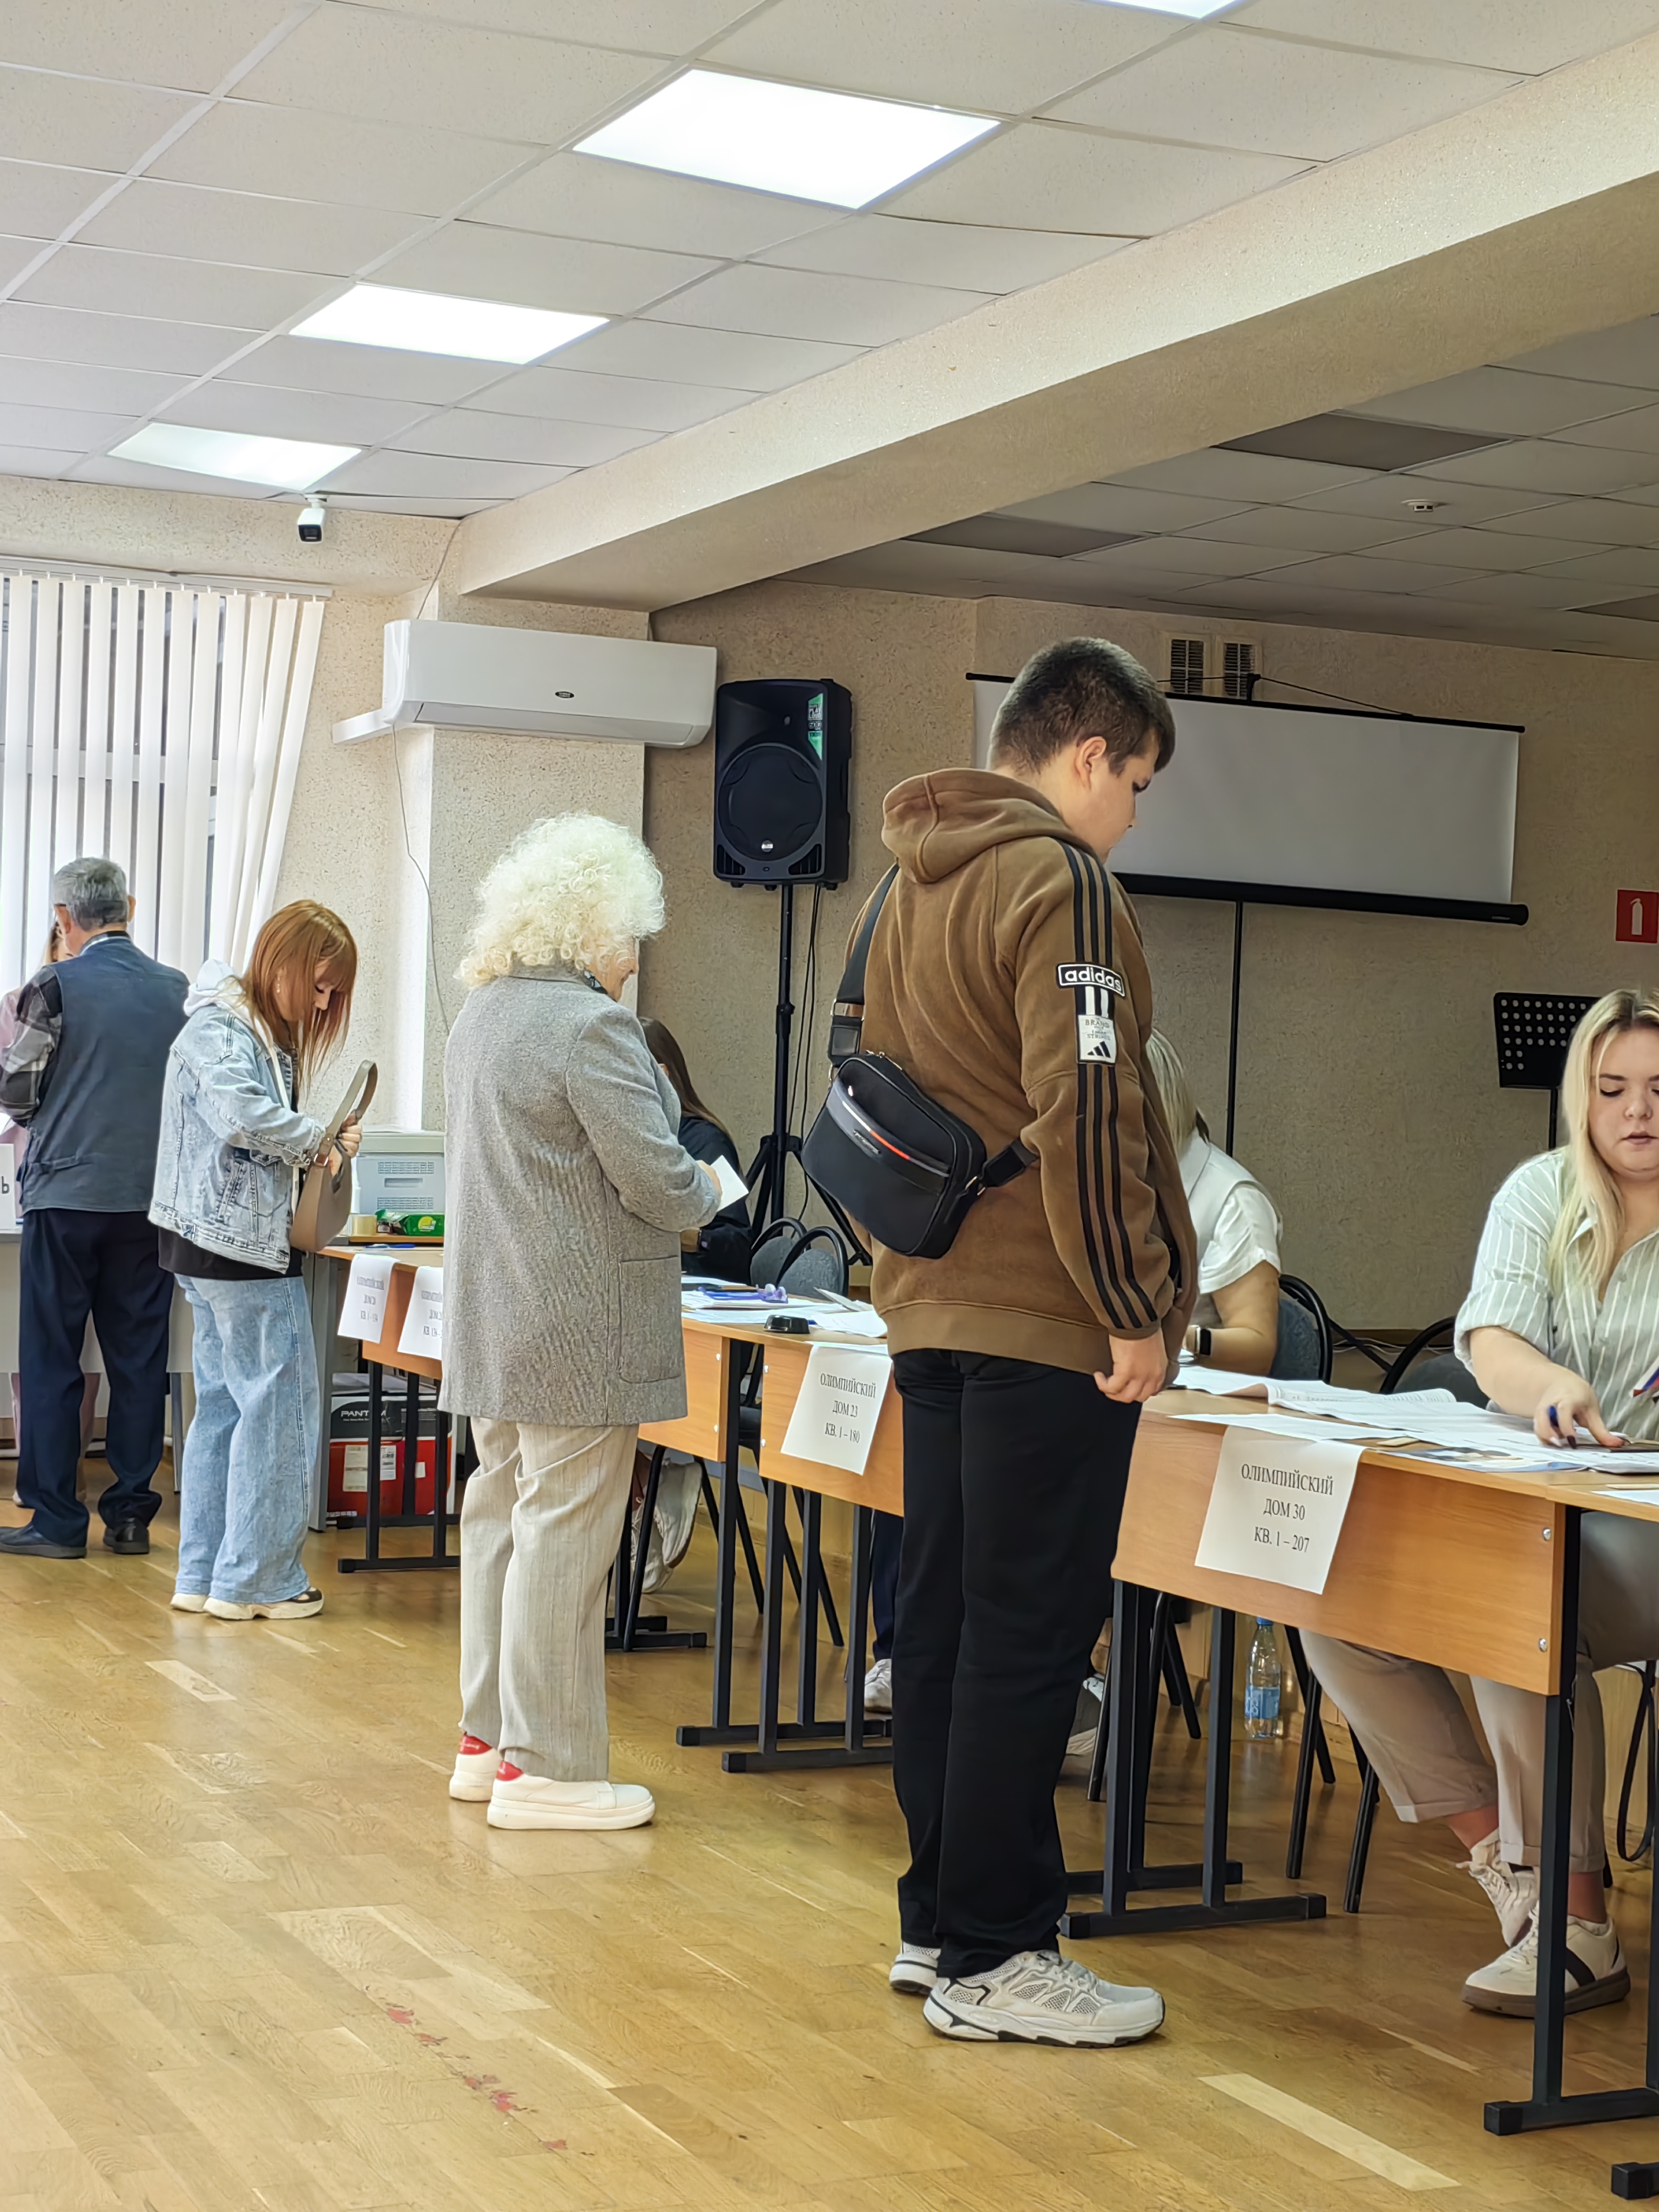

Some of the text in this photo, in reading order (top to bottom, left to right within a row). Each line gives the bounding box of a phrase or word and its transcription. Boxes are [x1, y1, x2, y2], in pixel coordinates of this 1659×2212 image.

[1065, 967, 1122, 992] adidas
[820, 1373, 876, 1399] ОЛИМПИЙСКИЙ
[832, 1400, 858, 1418] ДОМ 23
[825, 1422, 837, 1437] КВ.
[839, 1426, 842, 1438] 1
[849, 1429, 860, 1443] 180
[1241, 1464, 1334, 1495] ОЛИМПИЙСКИЙ
[1263, 1498, 1305, 1520] ДОМ 30
[1254, 1526, 1272, 1545] КВ.
[1276, 1531, 1280, 1547] 1
[1292, 1535, 1310, 1553] 207
